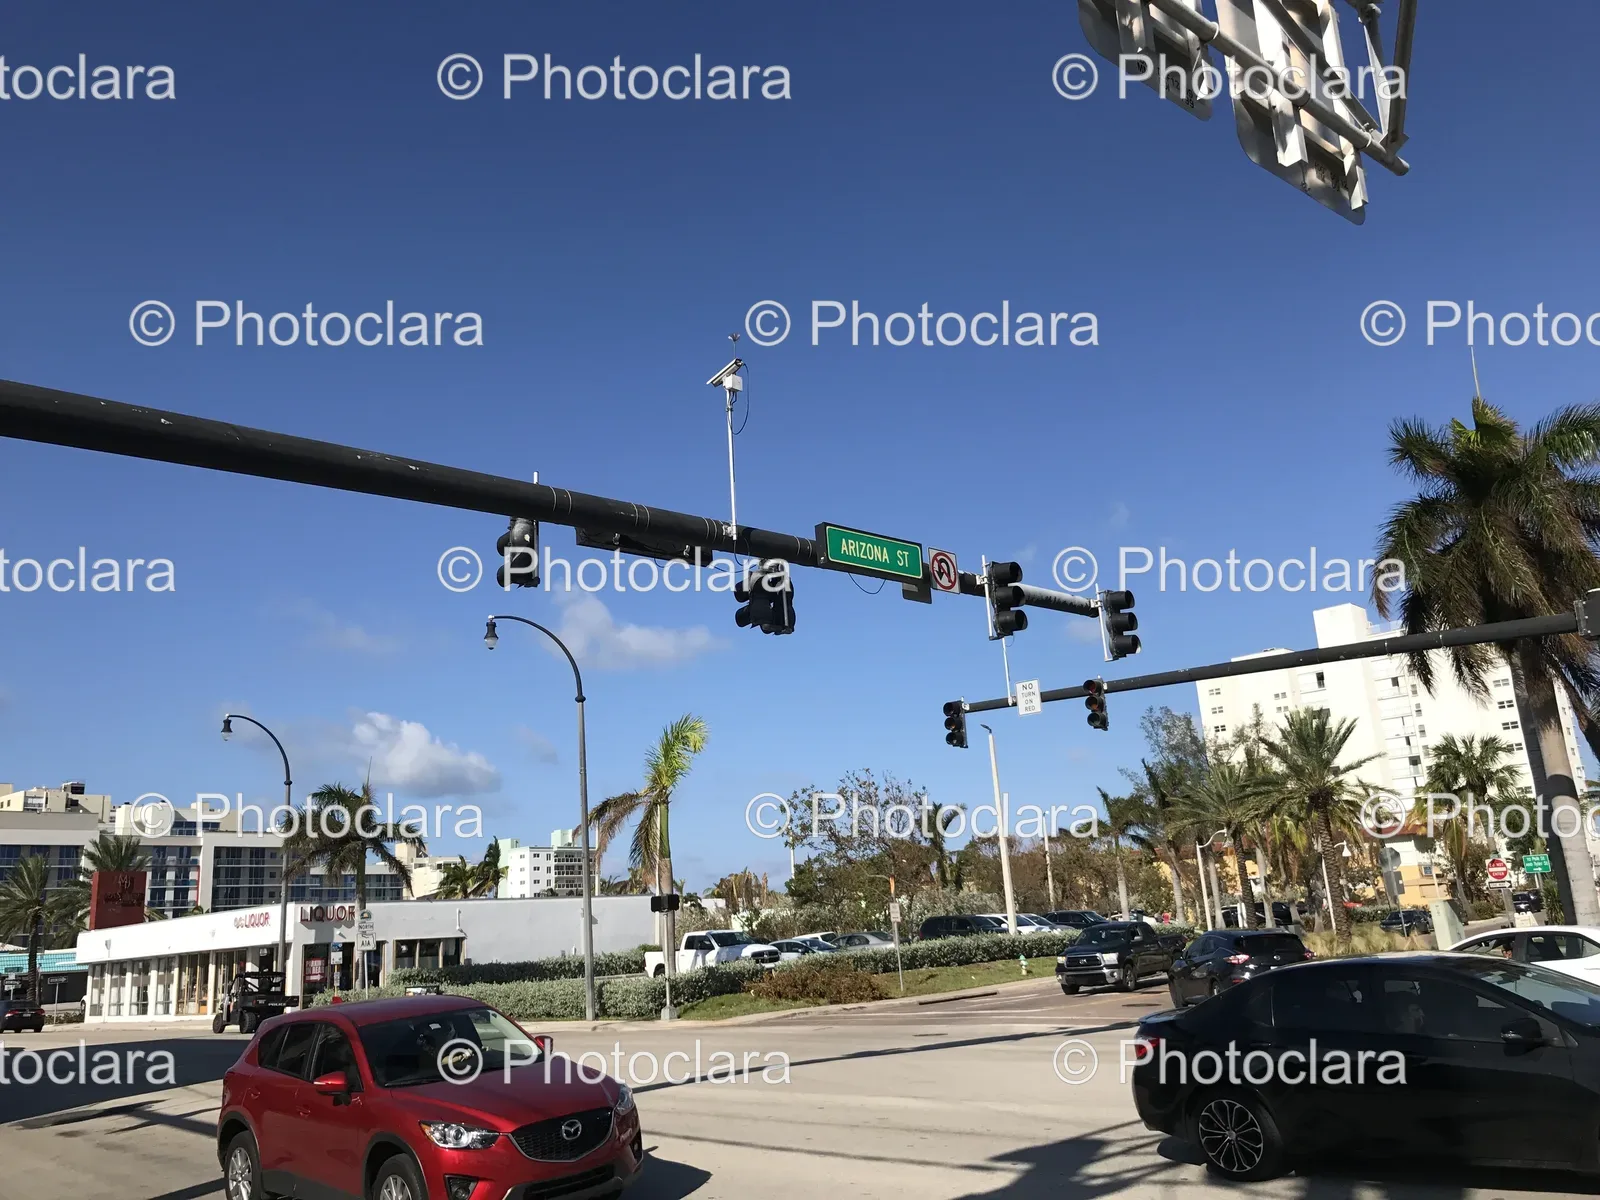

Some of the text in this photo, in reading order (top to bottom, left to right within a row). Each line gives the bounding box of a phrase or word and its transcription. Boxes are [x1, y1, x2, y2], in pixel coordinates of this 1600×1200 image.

[841, 538, 909, 567] ARIZONA ST
[245, 912, 270, 928] LIQUOR
[301, 905, 356, 922] LIQUOR
